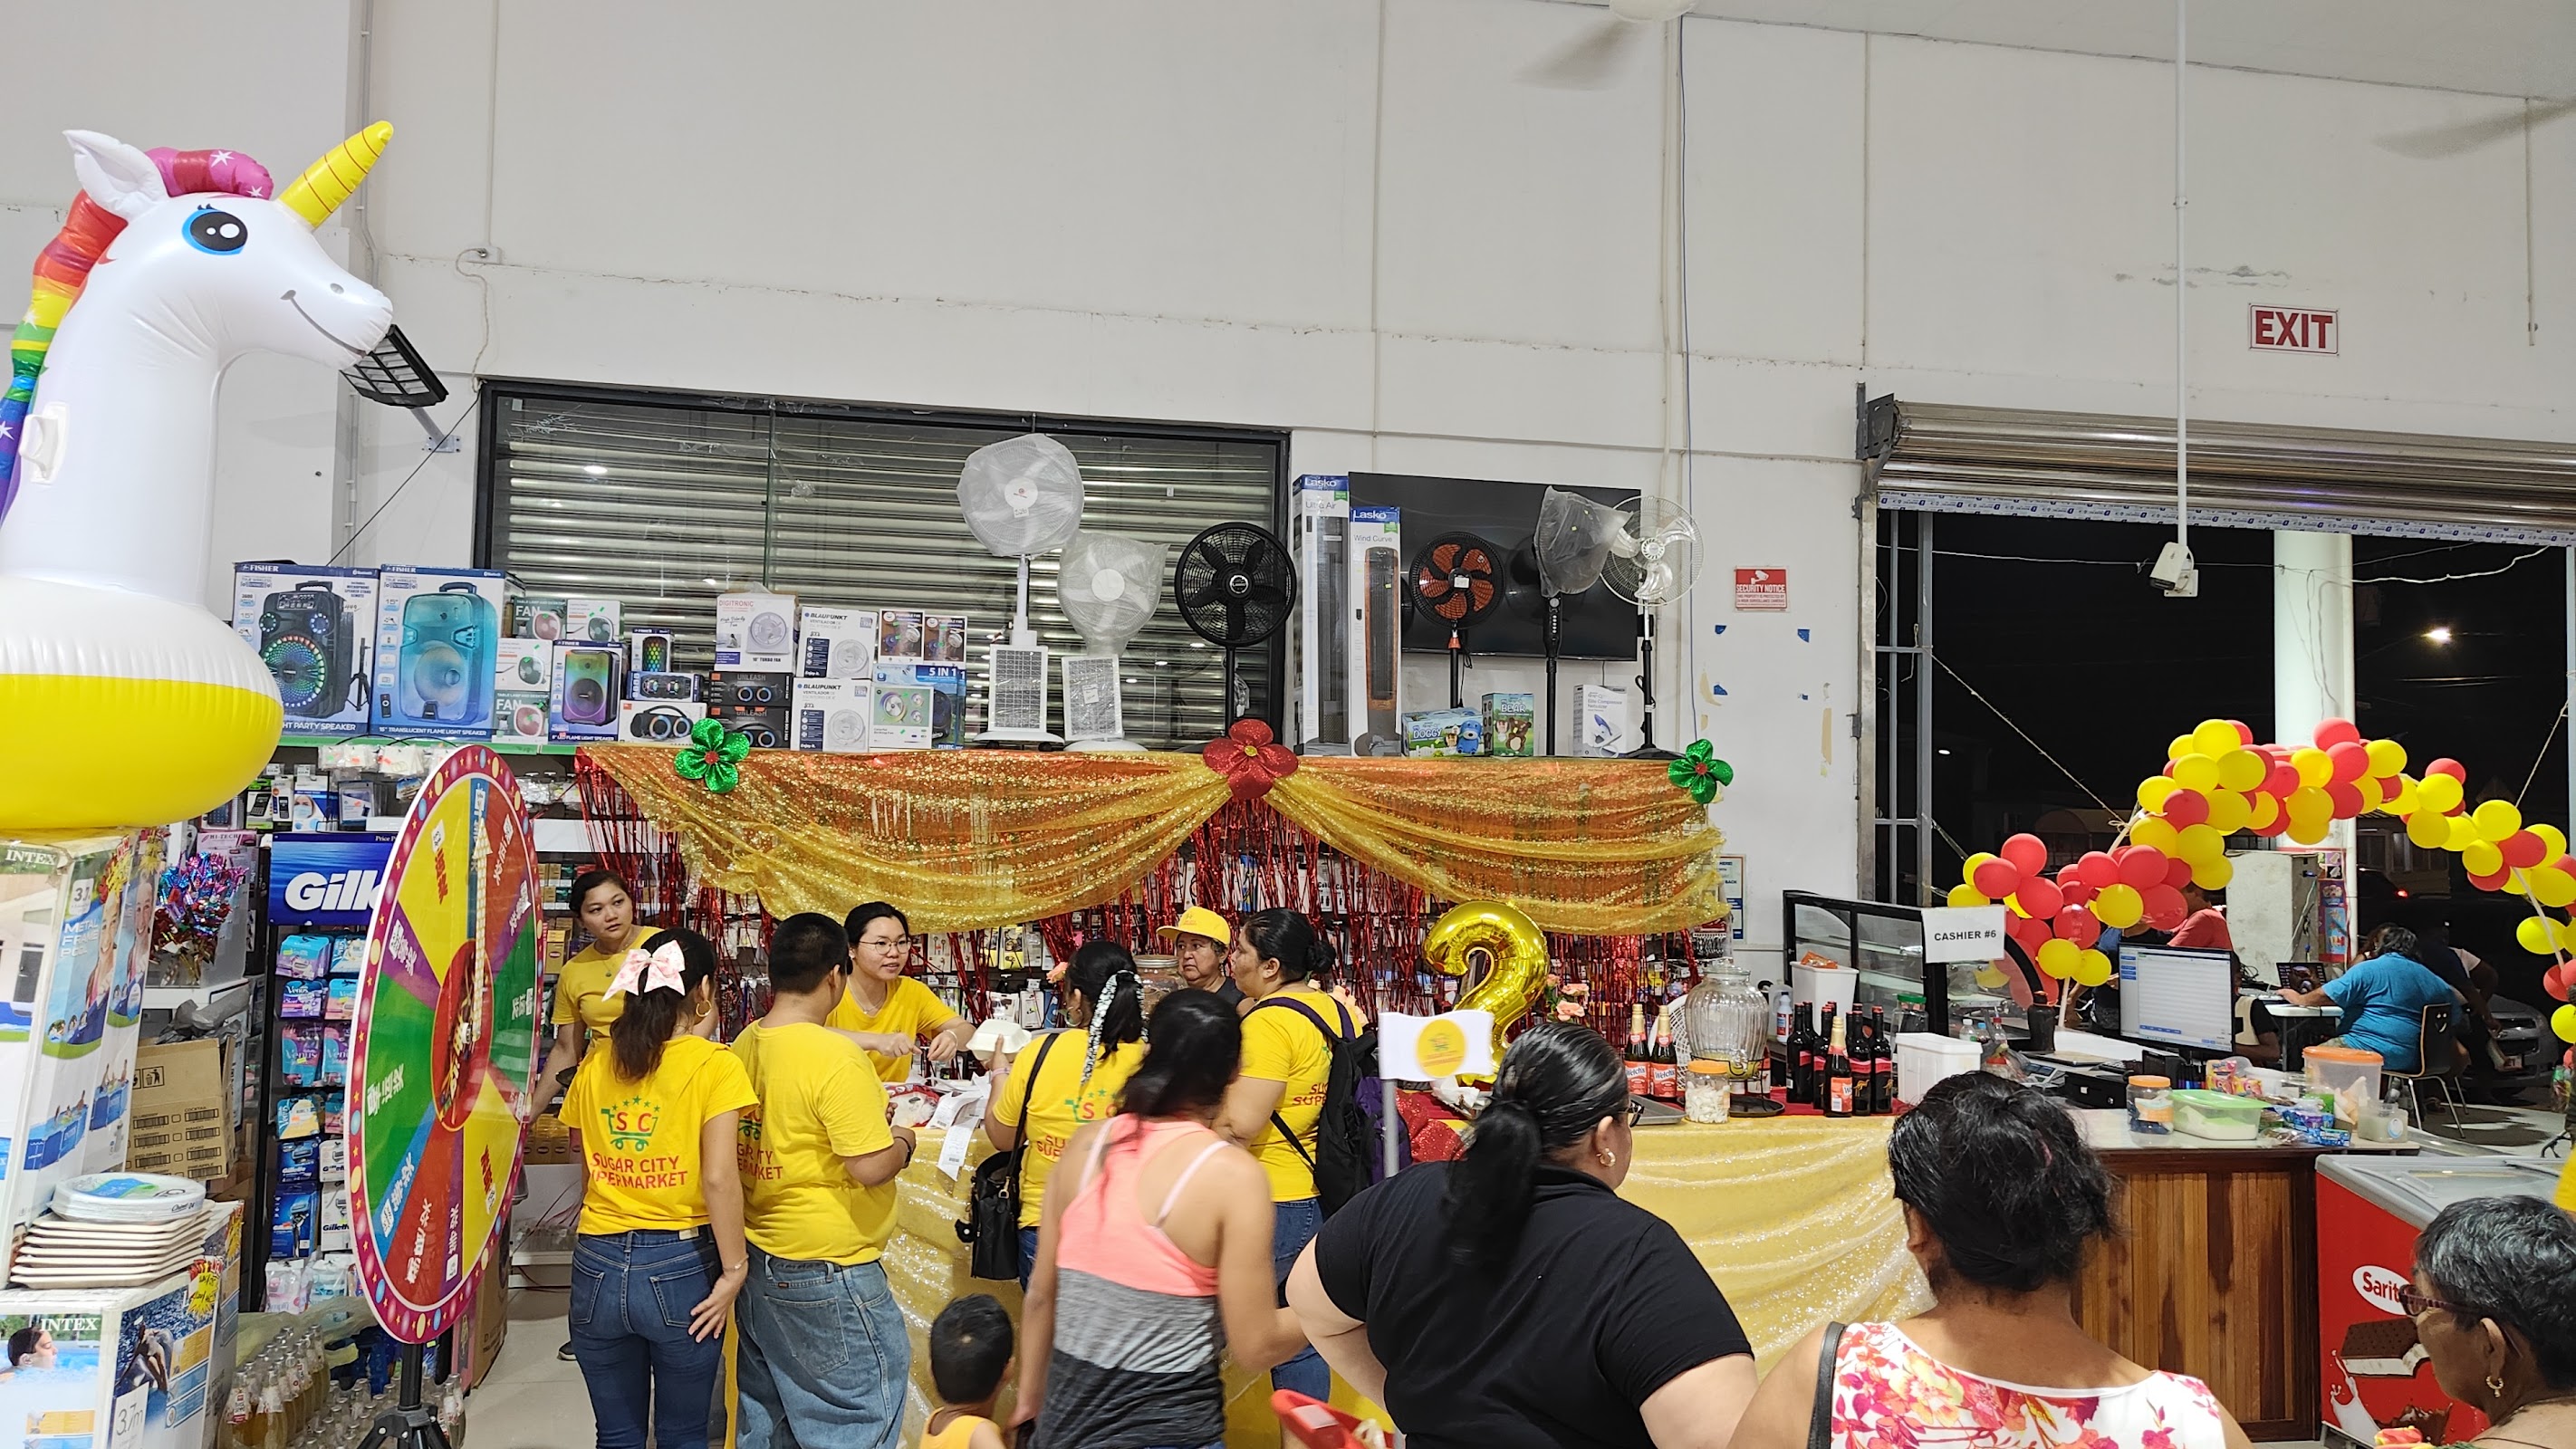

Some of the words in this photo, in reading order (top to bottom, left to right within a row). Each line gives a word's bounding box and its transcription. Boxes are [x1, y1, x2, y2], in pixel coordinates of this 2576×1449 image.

[2255, 311, 2332, 349] EXIT
[1304, 477, 1337, 487] Lasko
[1353, 509, 1387, 520] Lasko
[250, 564, 279, 572] FISHER
[1736, 584, 1764, 593] SECURITY
[1764, 584, 1785, 593] NOTICE
[515, 605, 541, 617] FAN
[928, 667, 936, 677] 5
[937, 668, 948, 677] IN
[951, 668, 956, 677] 1
[960, 671, 966, 679] 1
[496, 698, 522, 711] FAN
[1501, 703, 1526, 713] BEAR
[293, 722, 321, 730] PARTY
[321, 723, 356, 731] SPEAKER
[1413, 728, 1442, 738] DOGGY
[5, 849, 57, 866] INTEX
[64, 920, 99, 934] METAL
[62, 931, 100, 946] FRAME
[1934, 930, 1982, 941] CASHIER
[1984, 929, 1996, 938] #6
[60, 947, 89, 958] POOL
[286, 985, 309, 994] Venus
[285, 1049, 317, 1059] Venus
[1626, 1066, 1646, 1078] Welch's
[1655, 1068, 1676, 1080] Welch's
[616, 1111, 629, 1131] S
[638, 1112, 652, 1132] C
[591, 1152, 634, 1174] SUGAR
[639, 1155, 680, 1174] CITY
[591, 1169, 688, 1189] PERMARKET
[322, 1223, 350, 1232] Gillett
[2362, 1271, 2400, 1303] Sarit
[41, 1318, 100, 1331] INTEX
[116, 1403, 143, 1436] 3.7m
